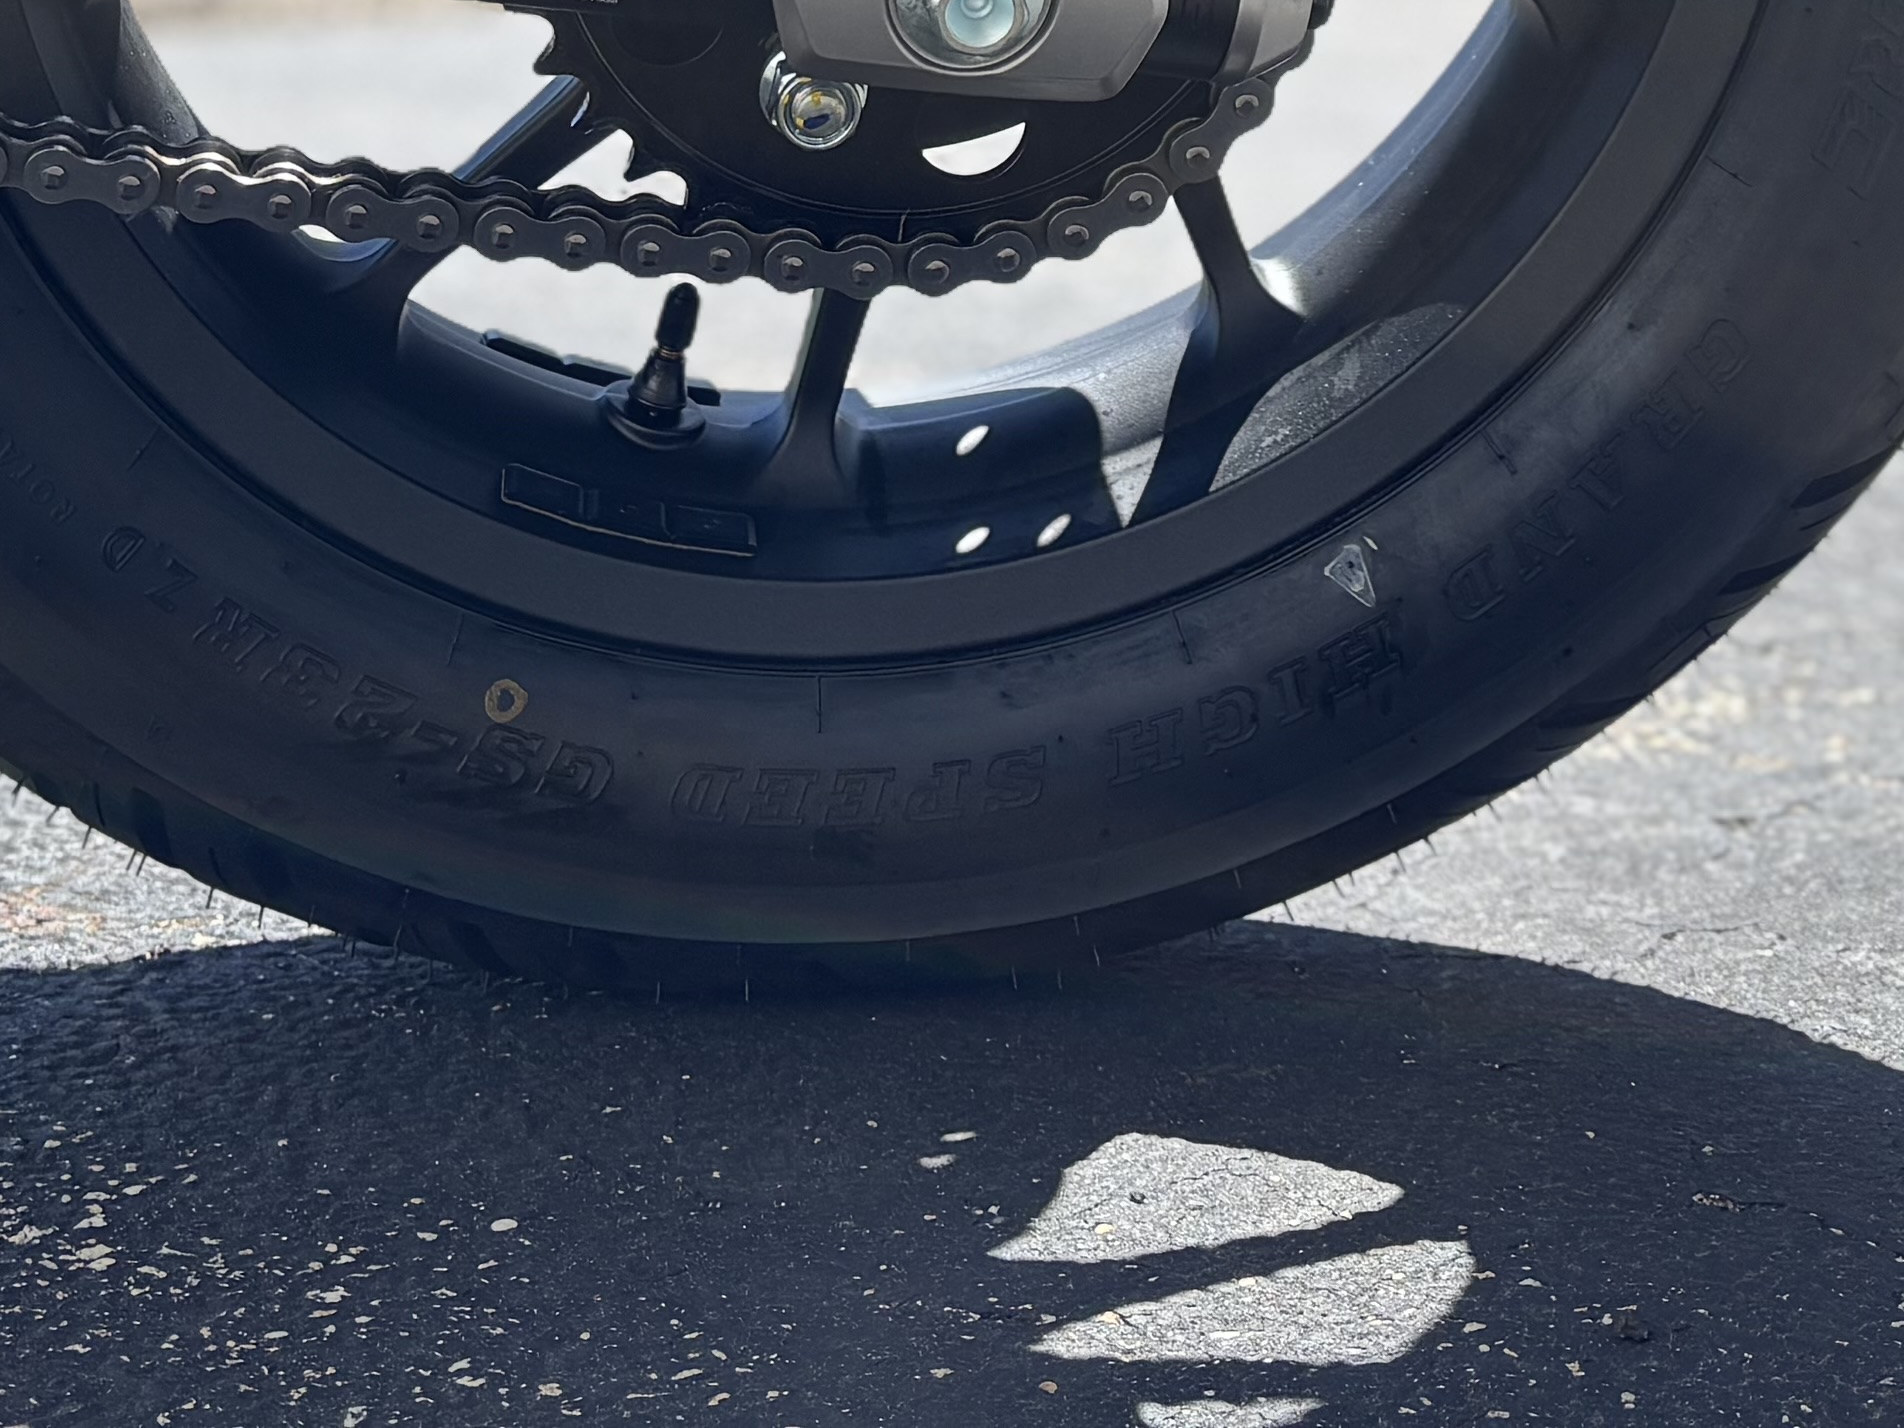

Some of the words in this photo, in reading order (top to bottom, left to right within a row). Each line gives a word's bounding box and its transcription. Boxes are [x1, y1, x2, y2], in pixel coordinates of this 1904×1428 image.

[1449, 317, 1751, 626] GRAND
[670, 744, 1048, 827] SPEED
[1108, 600, 1402, 788] HIGH
